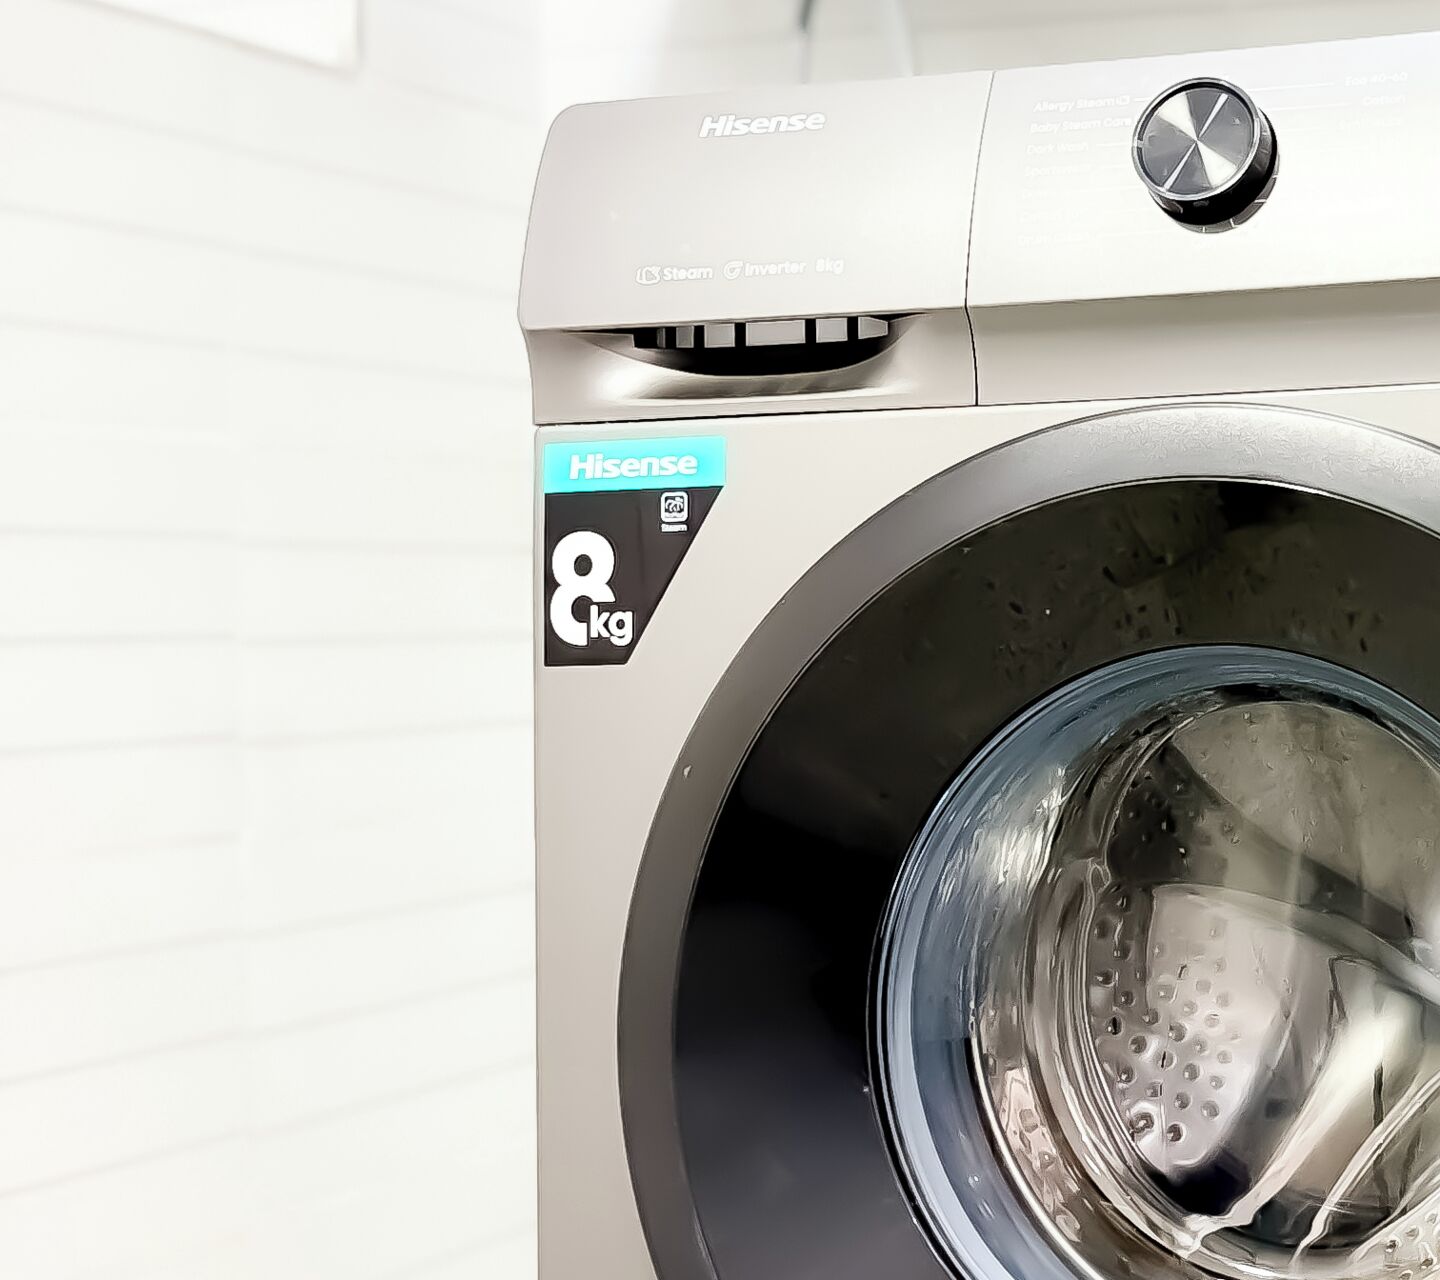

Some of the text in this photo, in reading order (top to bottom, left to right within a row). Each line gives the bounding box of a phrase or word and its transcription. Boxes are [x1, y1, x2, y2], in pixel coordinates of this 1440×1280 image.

[700, 113, 825, 137] Hisense
[663, 265, 713, 280] Steam
[745, 261, 806, 276] Inverter
[569, 453, 698, 480] Hisense
